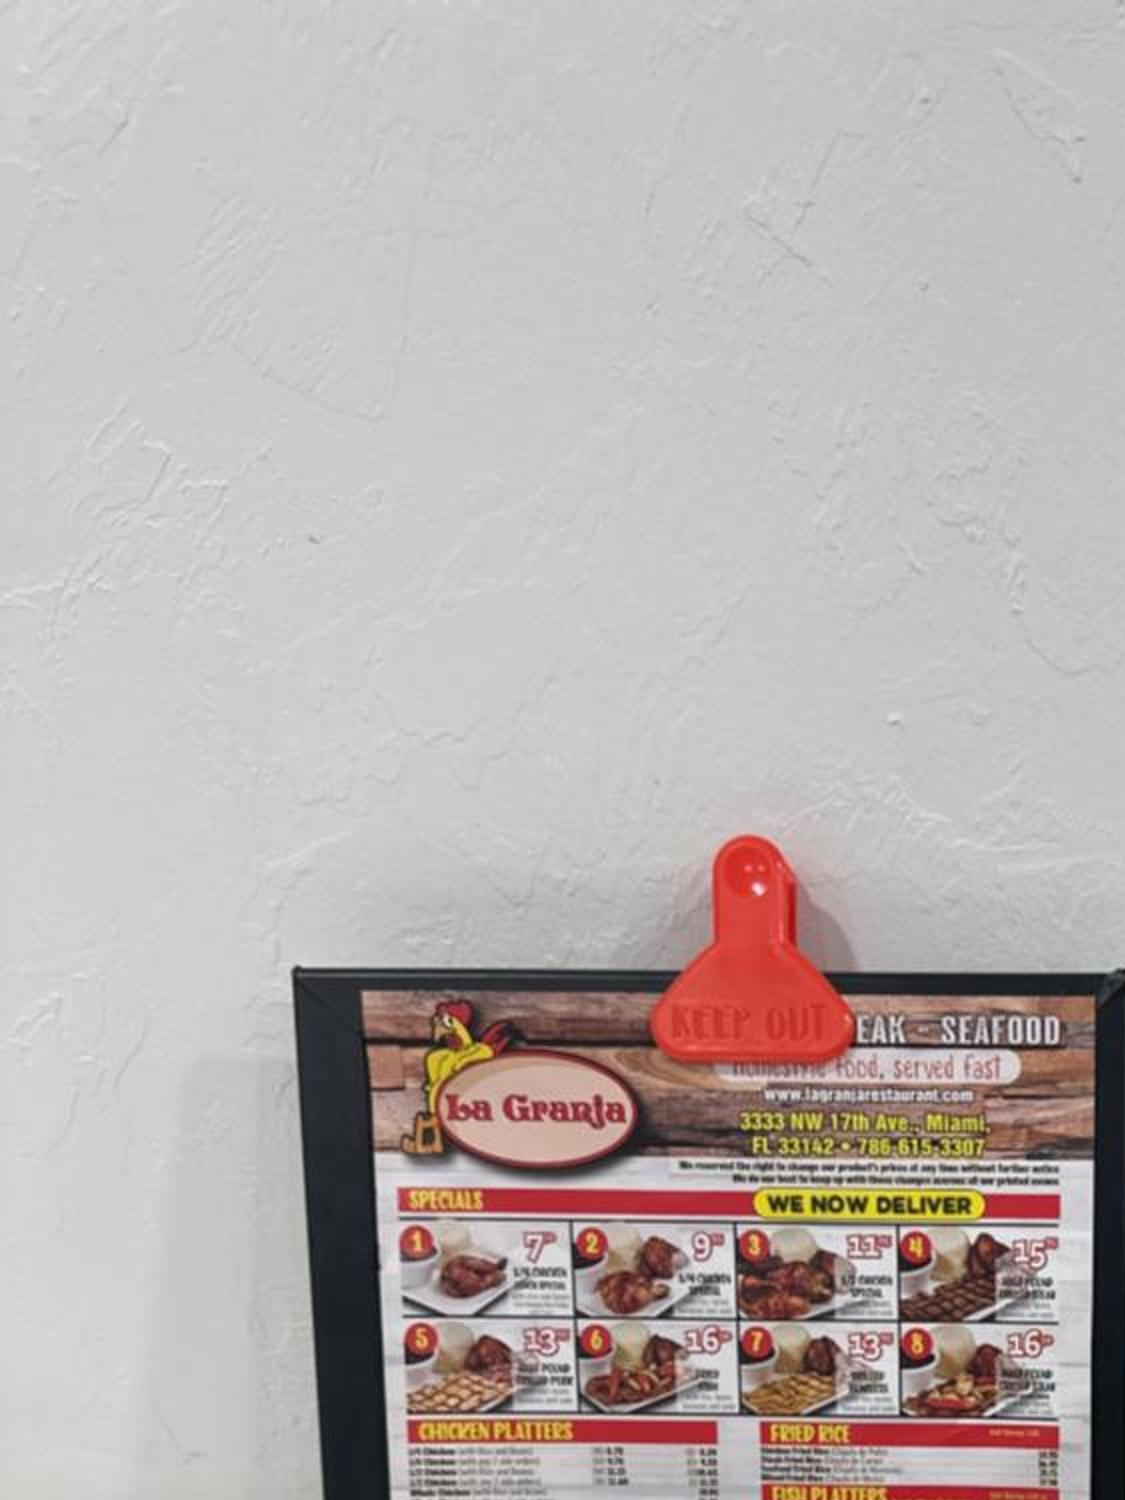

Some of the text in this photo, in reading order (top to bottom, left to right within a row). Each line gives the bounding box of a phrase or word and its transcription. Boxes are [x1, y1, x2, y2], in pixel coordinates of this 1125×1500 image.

[672, 1003, 829, 1041] KEEP OUT
[856, 1015, 906, 1044] EAK
[941, 1016, 1060, 1045] SEAFOOD
[894, 1055, 954, 1079] served
[764, 1086, 974, 1104] www.lagranjarestaurant.com
[446, 1094, 627, 1130] La Granja
[739, 1113, 784, 1131] 3333
[790, 1113, 823, 1131] NW
[831, 1113, 869, 1131] 17th
[925, 1114, 991, 1133] Miami,
[752, 1137, 772, 1155] FL
[779, 1137, 834, 1155] 33142
[408, 1190, 484, 1210] SPECIALS
[768, 1195, 972, 1214] WE NOW DELIVER
[412, 1230, 424, 1250] 1
[586, 1233, 598, 1254] 2
[749, 1233, 761, 1254] 3
[909, 1234, 923, 1257] 4
[415, 1327, 428, 1349] 5
[590, 1330, 602, 1351] 6
[751, 1331, 763, 1352] 7
[910, 1331, 923, 1353] 8
[419, 1422, 574, 1441] CHICKEN PLATTERS
[770, 1424, 850, 1443] FRIED RICE
